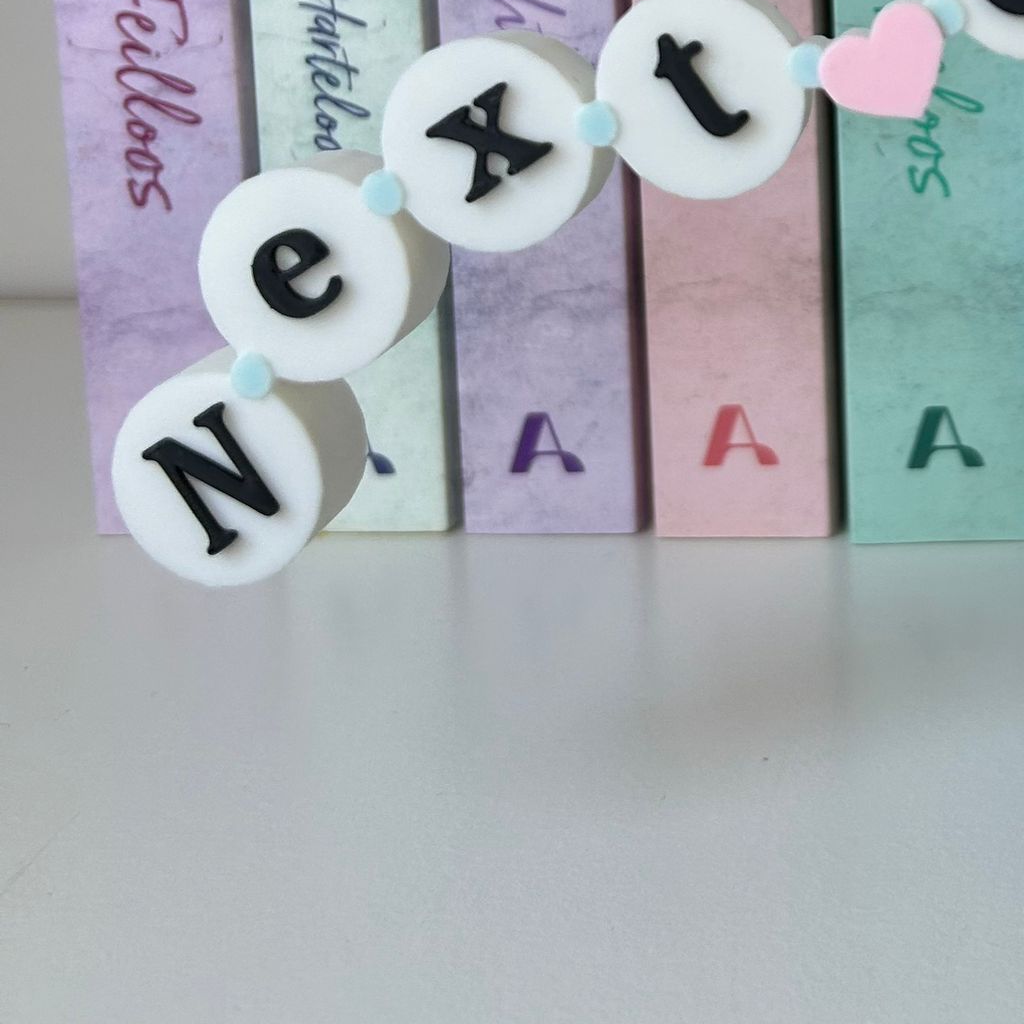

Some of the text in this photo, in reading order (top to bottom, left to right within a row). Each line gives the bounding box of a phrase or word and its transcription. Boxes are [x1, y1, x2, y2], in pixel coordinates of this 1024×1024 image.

[510, 411, 585, 473] A
[702, 404, 778, 467] A
[907, 405, 985, 469] A
